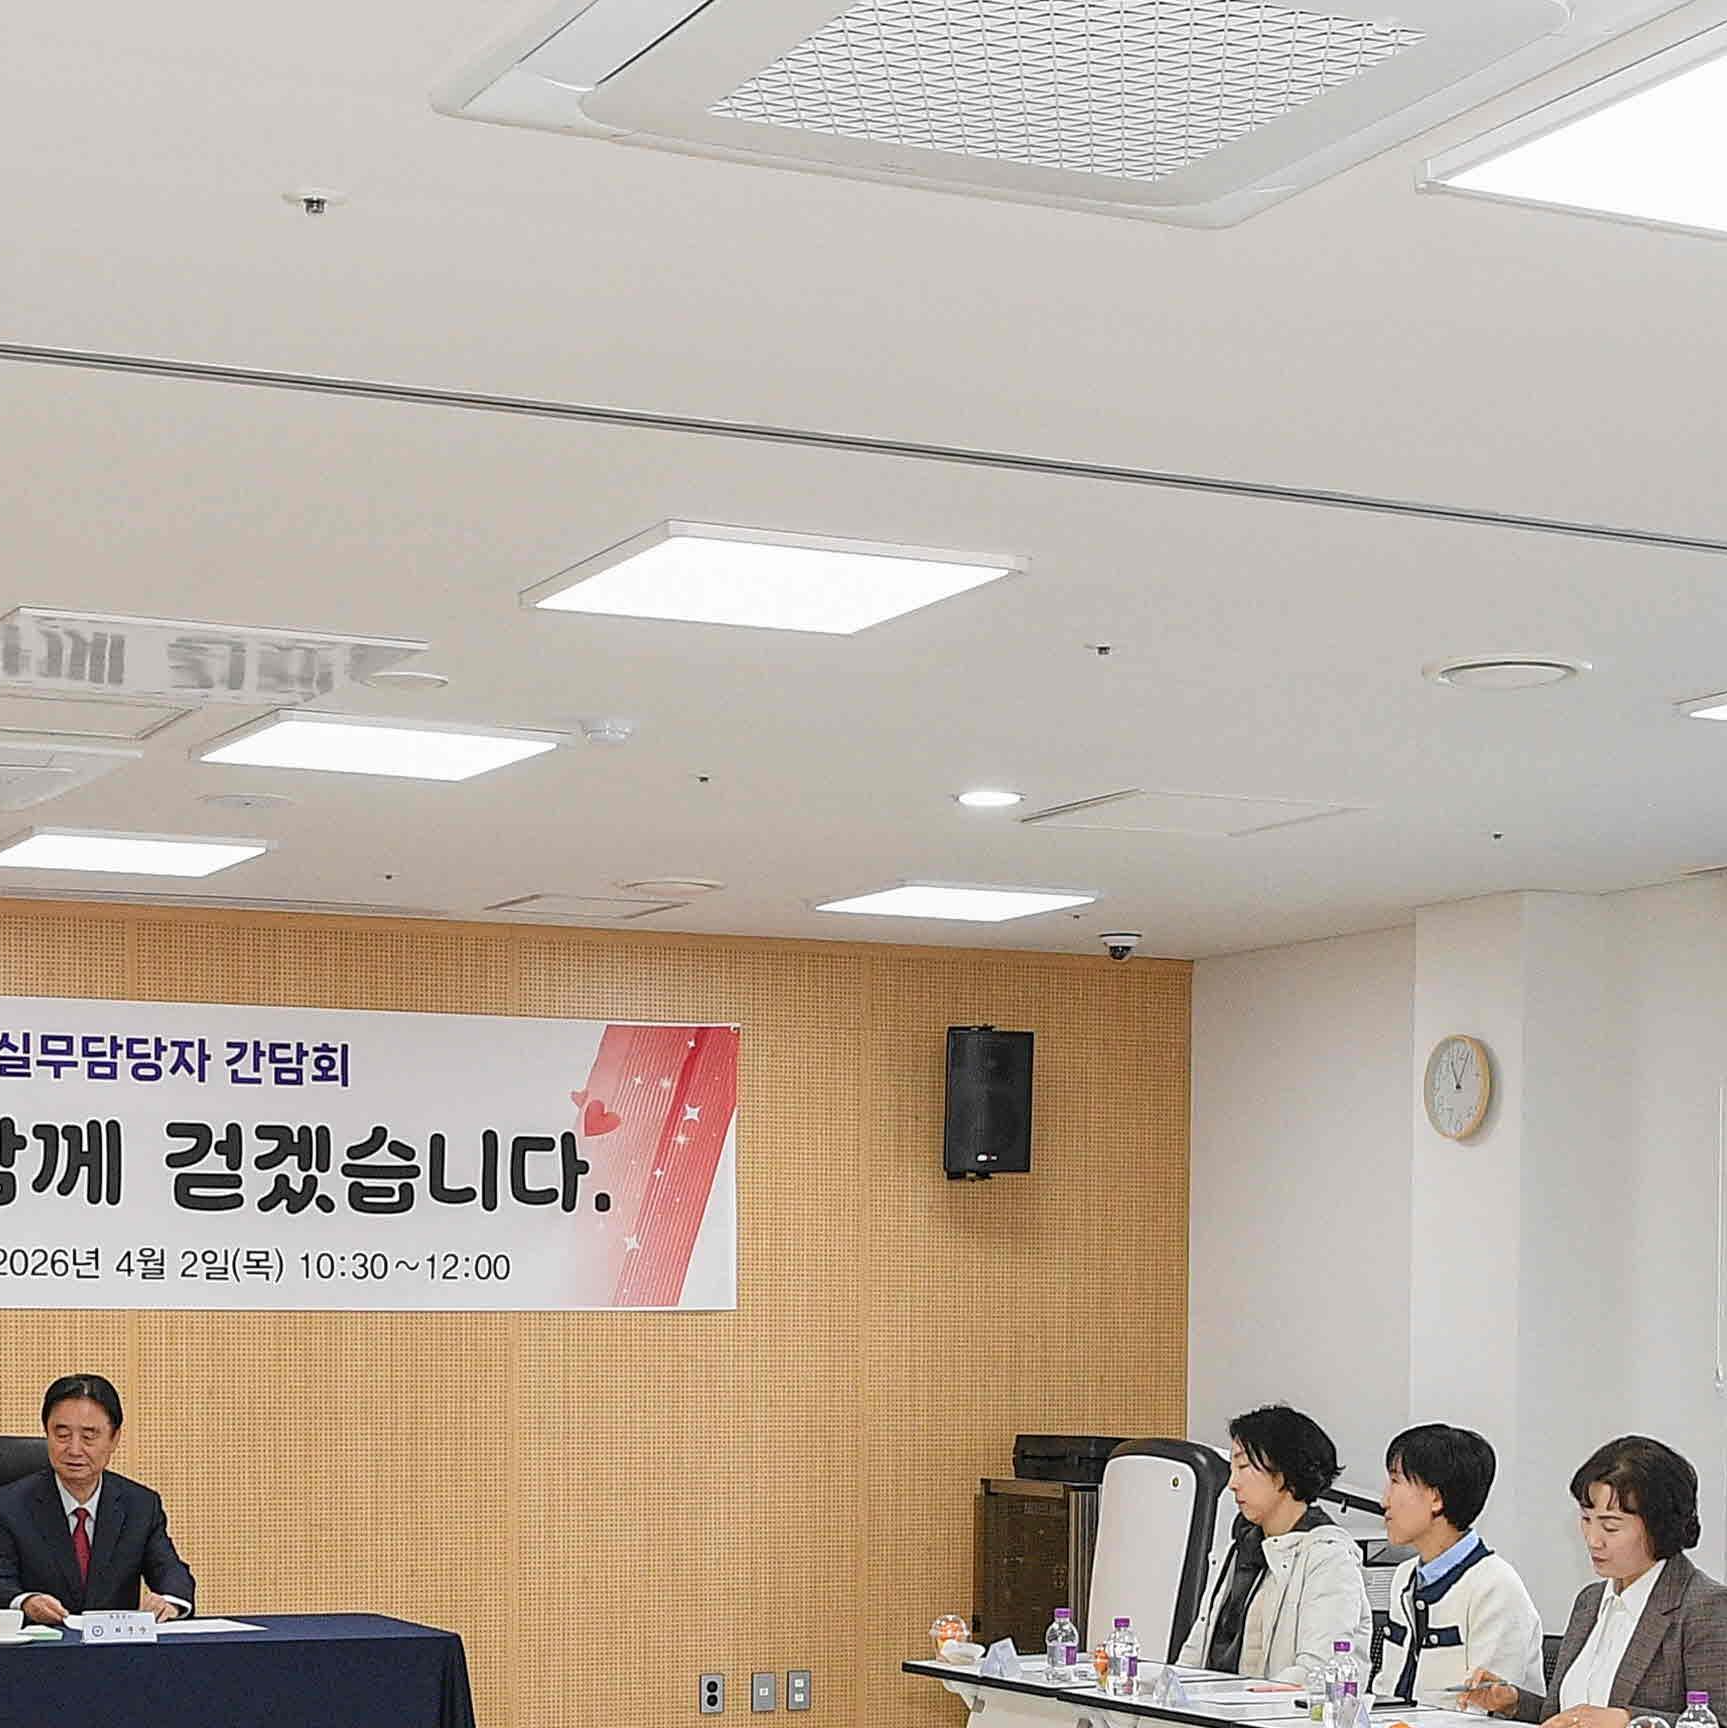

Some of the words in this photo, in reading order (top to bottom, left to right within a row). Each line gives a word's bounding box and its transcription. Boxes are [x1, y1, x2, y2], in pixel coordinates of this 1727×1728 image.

[225, 1040, 349, 1088] 간담회
[165, 1121, 612, 1215] 걷겠습니다.
[115, 1248, 166, 1280] 4월
[180, 1248, 284, 1283] 2일(목)
[299, 1252, 511, 1280] 10:30~12:00
